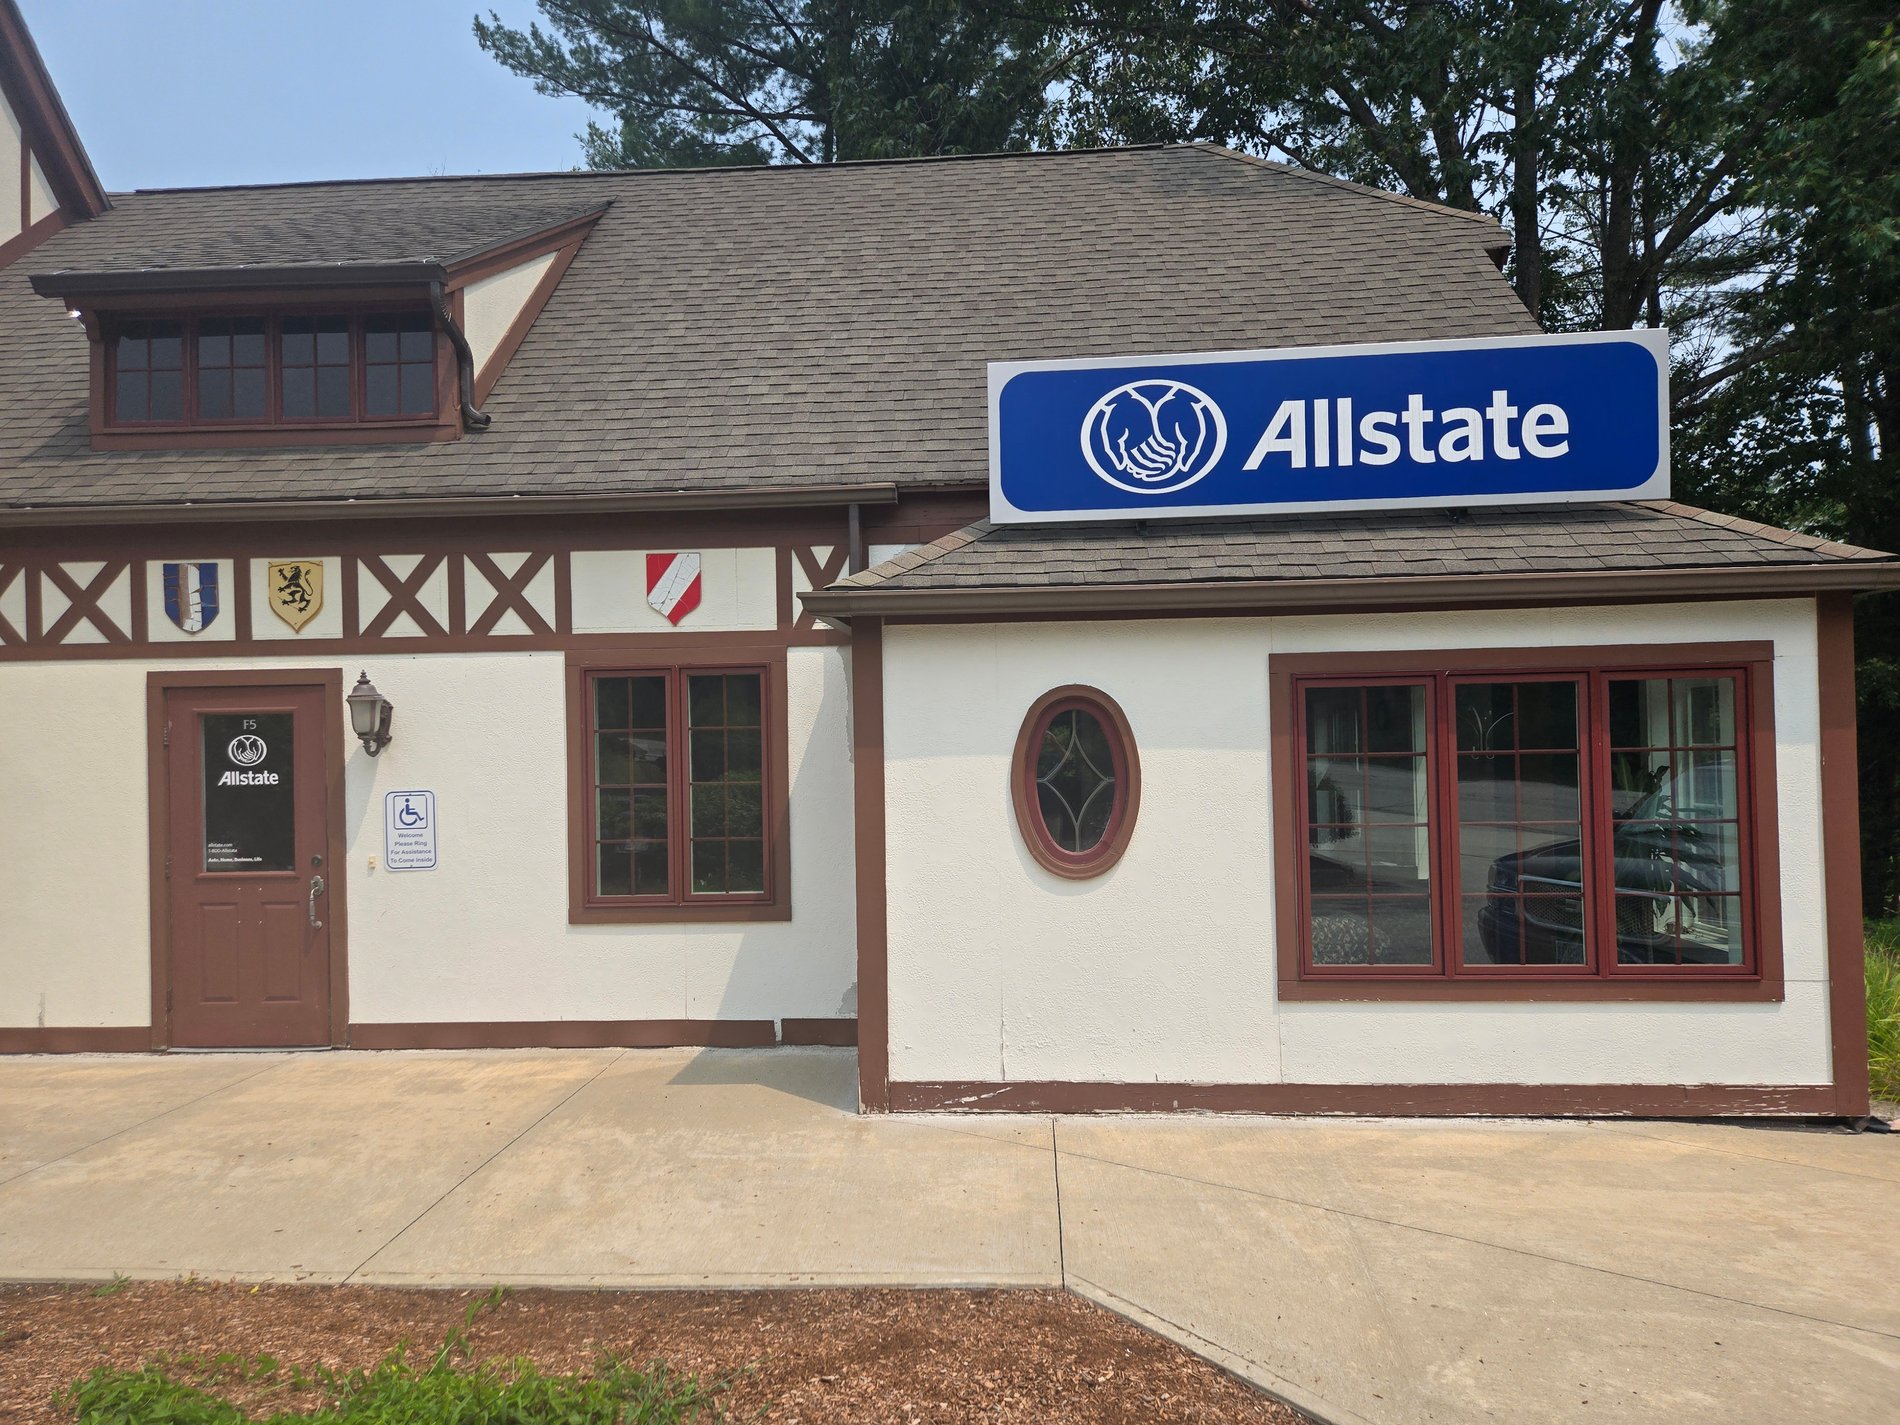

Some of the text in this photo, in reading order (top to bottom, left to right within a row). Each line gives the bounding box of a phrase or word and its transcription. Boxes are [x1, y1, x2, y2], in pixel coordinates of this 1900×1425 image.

[1242, 389, 1570, 471] Allstate
[243, 719, 257, 730] F5
[218, 770, 279, 786] Allstate
